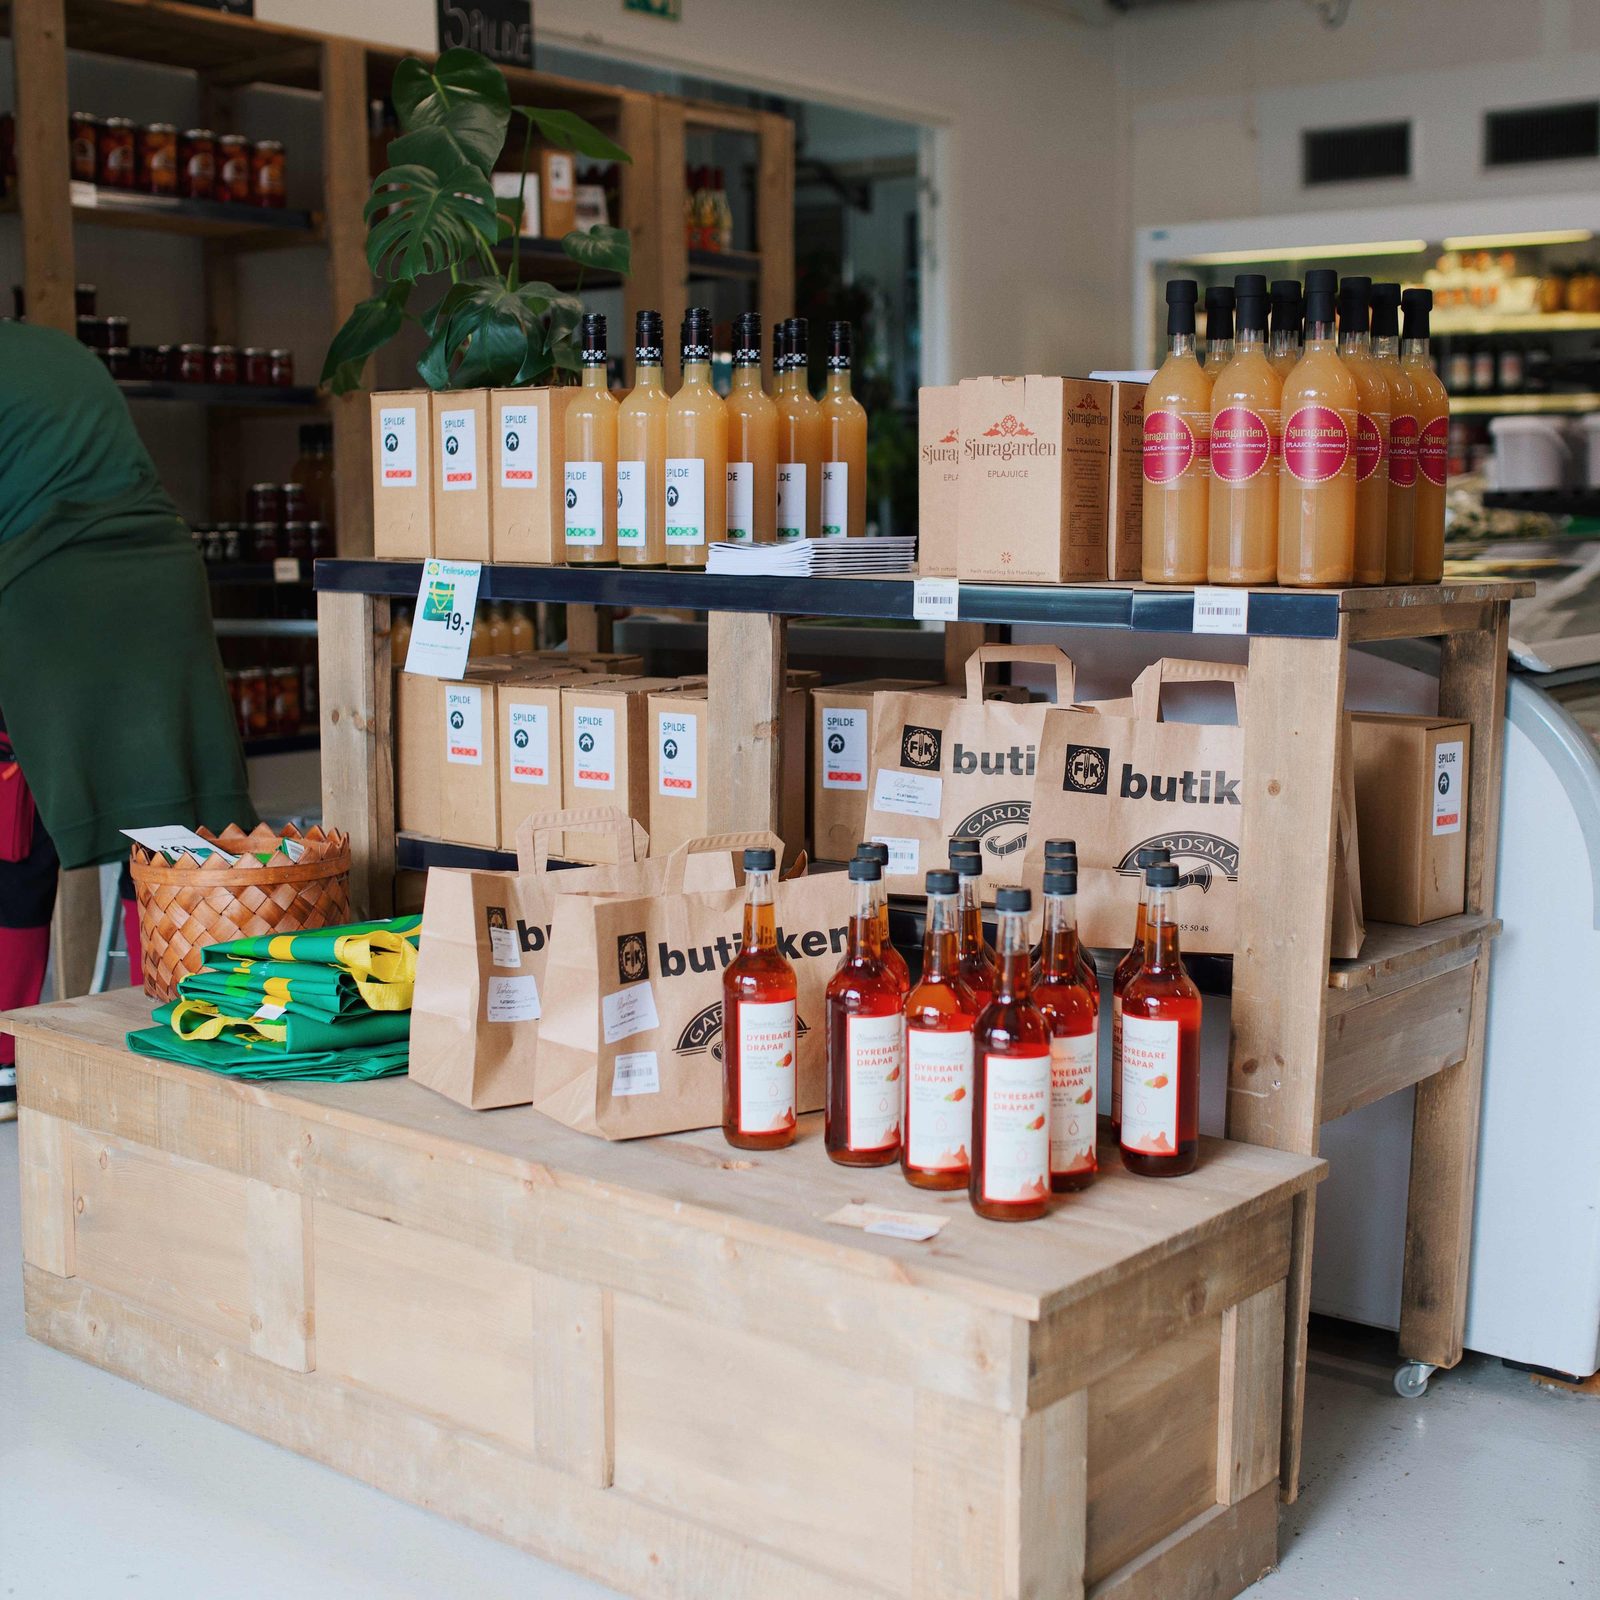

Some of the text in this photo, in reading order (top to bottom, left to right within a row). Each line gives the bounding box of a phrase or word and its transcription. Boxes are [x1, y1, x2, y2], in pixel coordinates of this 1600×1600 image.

[384, 417, 405, 426] SPILDE
[444, 419, 465, 428] SPILDE
[505, 415, 527, 424] SPILDE
[1289, 426, 1343, 439] Sjuragarden
[964, 438, 1056, 461] Sjuragarden
[988, 470, 1029, 478] EPLAJUICE
[445, 613, 470, 635] 19,-
[449, 695, 471, 705] SPILDE
[513, 713, 536, 723] SPILDE
[578, 716, 603, 726] SPILDE
[827, 717, 854, 727] SPILDE
[663, 722, 686, 732] SPILDE
[1438, 752, 1456, 764] SPILDE
[1120, 763, 1241, 805] butik
[746, 1030, 791, 1041] DYREBARE
[915, 1063, 964, 1072] DYREBARE
[993, 1090, 1045, 1099] DYREBARE
